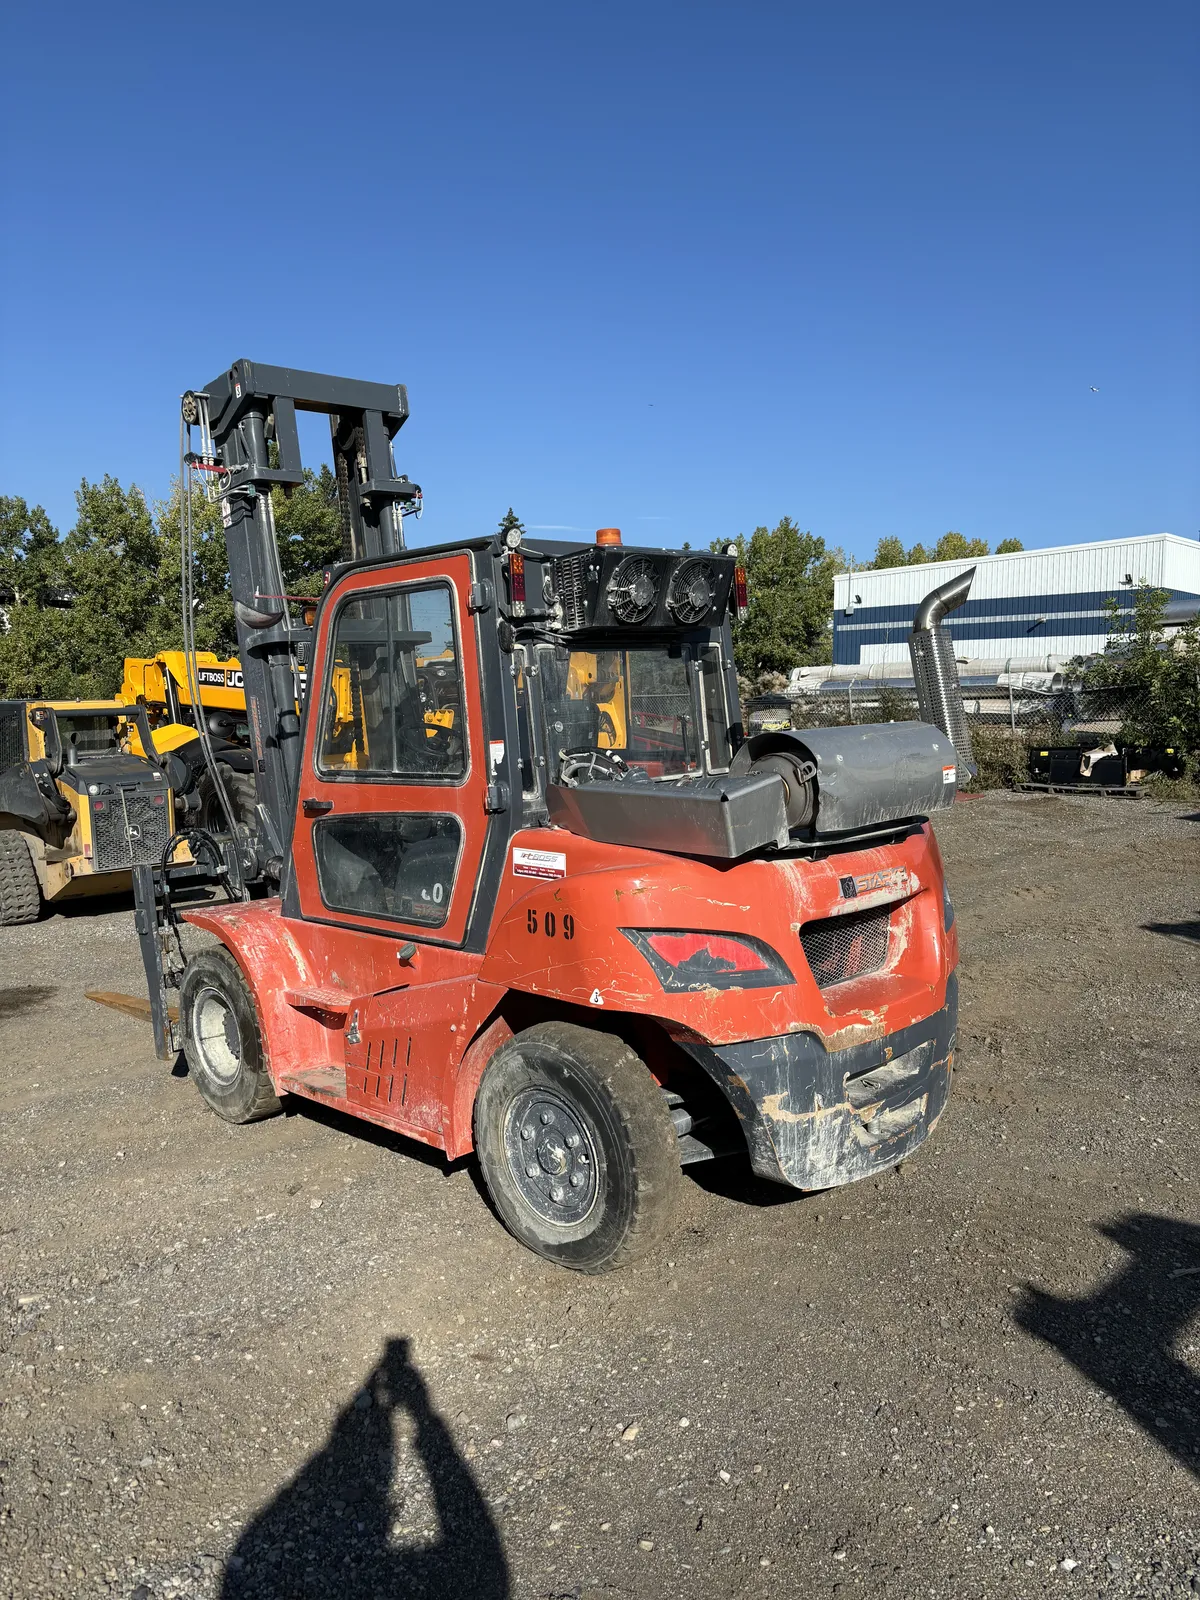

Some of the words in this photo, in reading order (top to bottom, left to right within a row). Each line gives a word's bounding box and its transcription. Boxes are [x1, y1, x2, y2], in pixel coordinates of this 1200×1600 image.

[199, 672, 224, 683] LIFTBOSS
[227, 671, 244, 687] JC
[527, 908, 574, 940] 509
